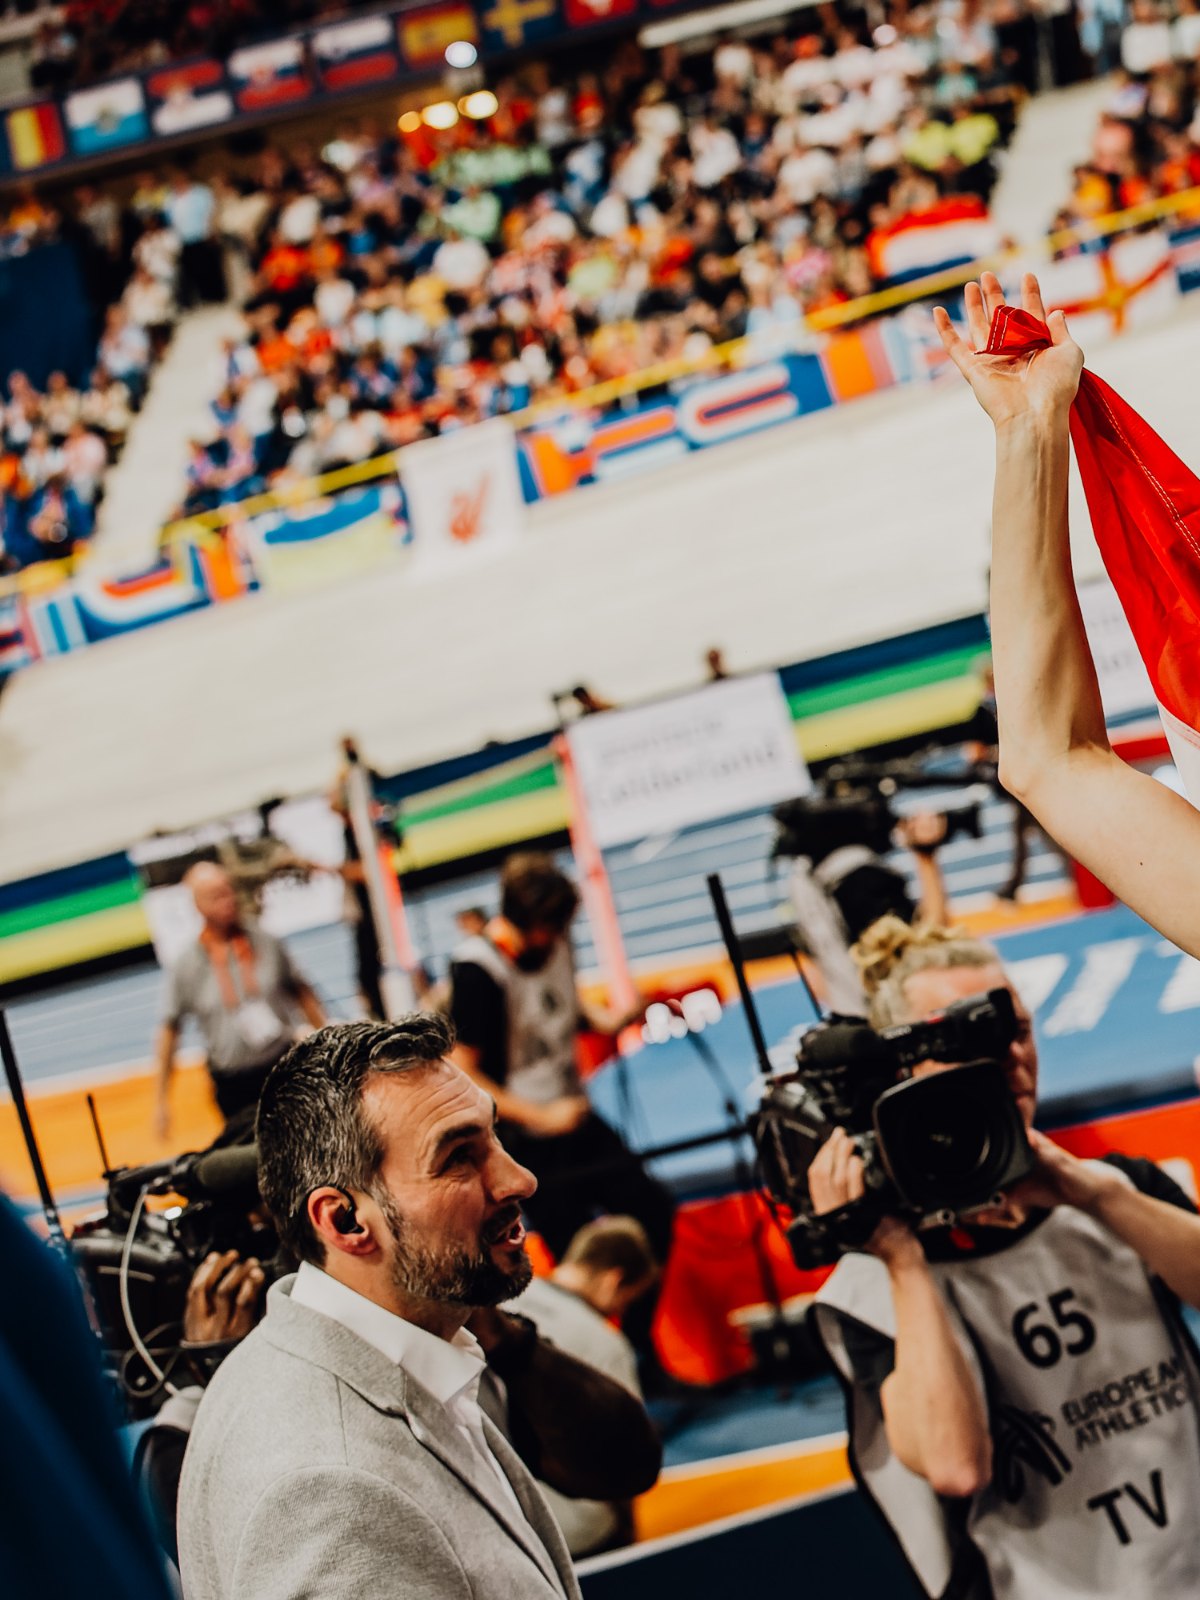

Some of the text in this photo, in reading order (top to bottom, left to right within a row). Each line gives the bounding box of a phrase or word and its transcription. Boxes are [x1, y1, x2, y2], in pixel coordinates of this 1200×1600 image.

[1011, 1286, 1097, 1371] 65
[1061, 1356, 1184, 1427] EUROPEAN
[1074, 1383, 1187, 1452] ATHLETIC
[1087, 1468, 1168, 1546] TV
